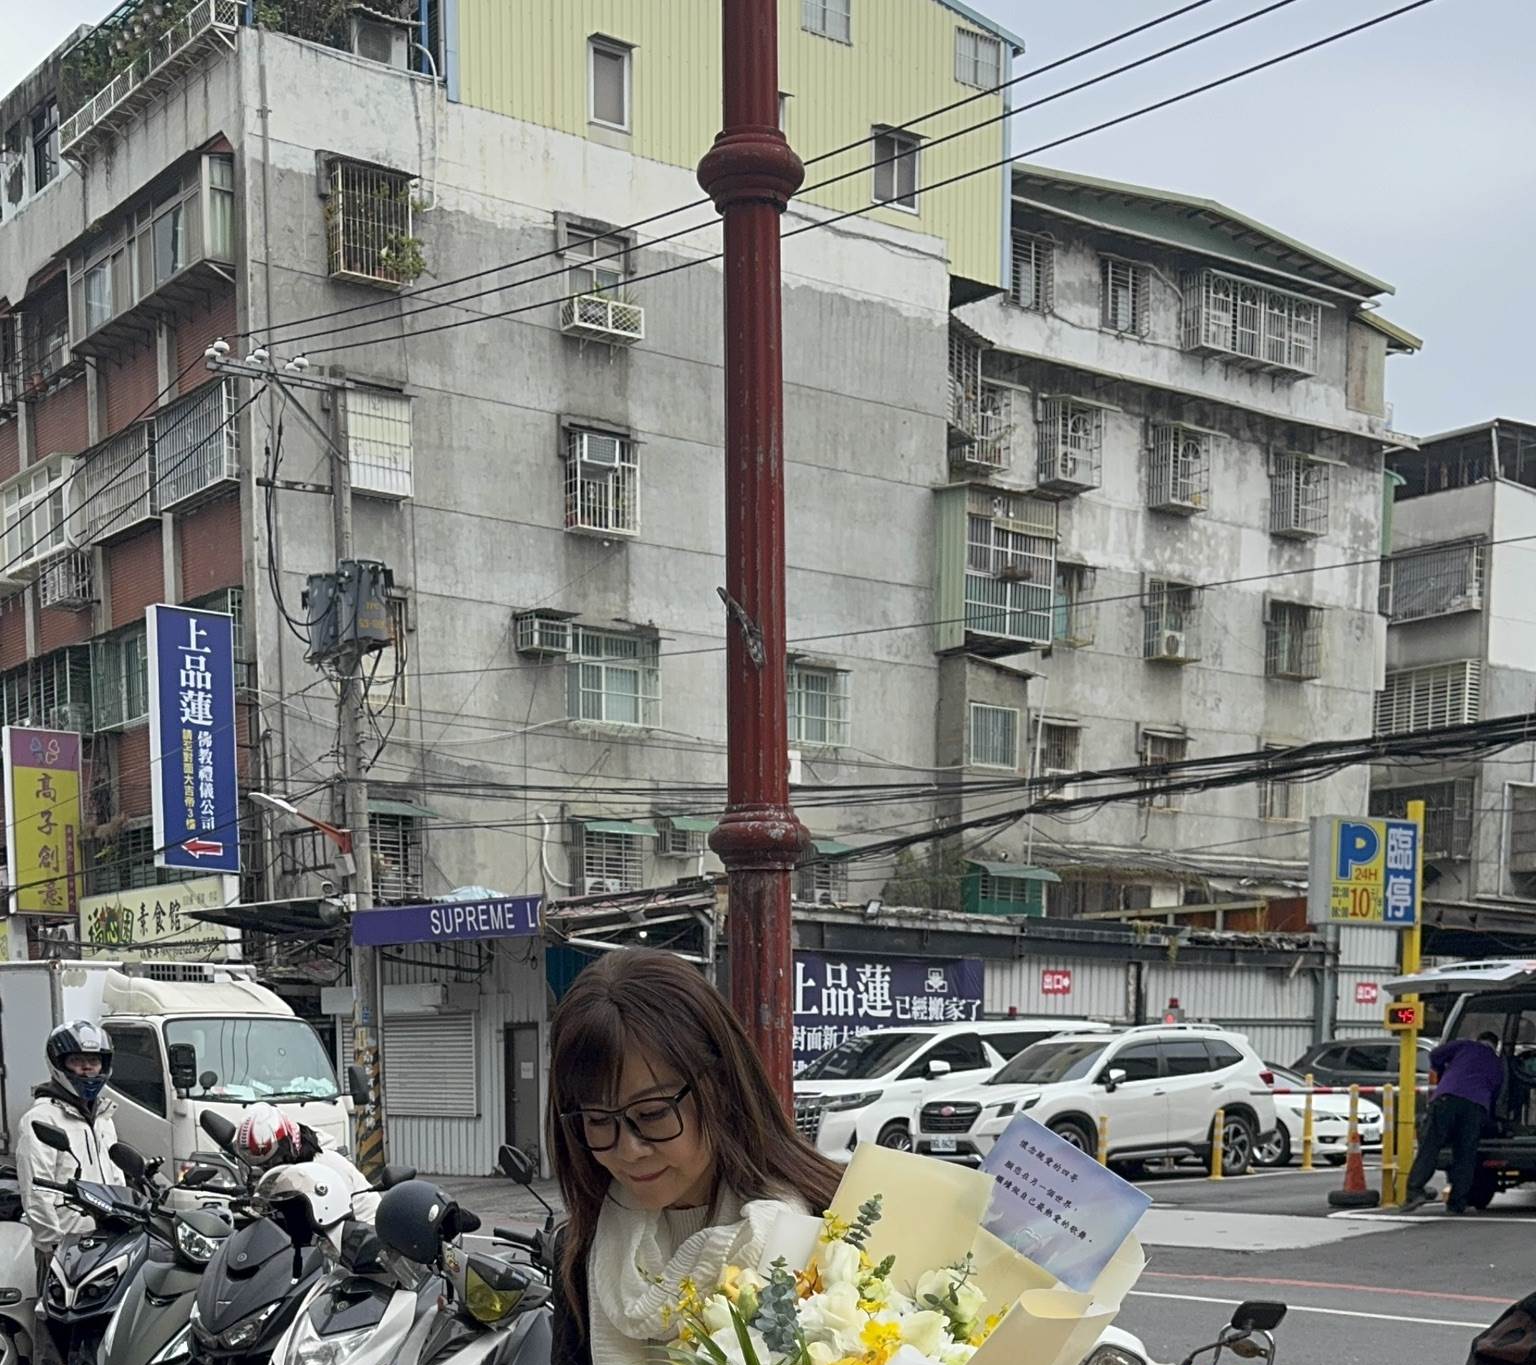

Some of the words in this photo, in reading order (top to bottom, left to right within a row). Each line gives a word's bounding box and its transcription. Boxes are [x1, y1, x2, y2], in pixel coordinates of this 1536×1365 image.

[178, 618, 213, 727] 上品蓮
[36, 773, 63, 906] 高子創意
[1354, 868, 1377, 881] 24H
[1386, 827, 1414, 918] 臨停
[1350, 887, 1370, 917] 10
[430, 903, 515, 934] SUPREME
[895, 995, 981, 1021] 已經搬家了
